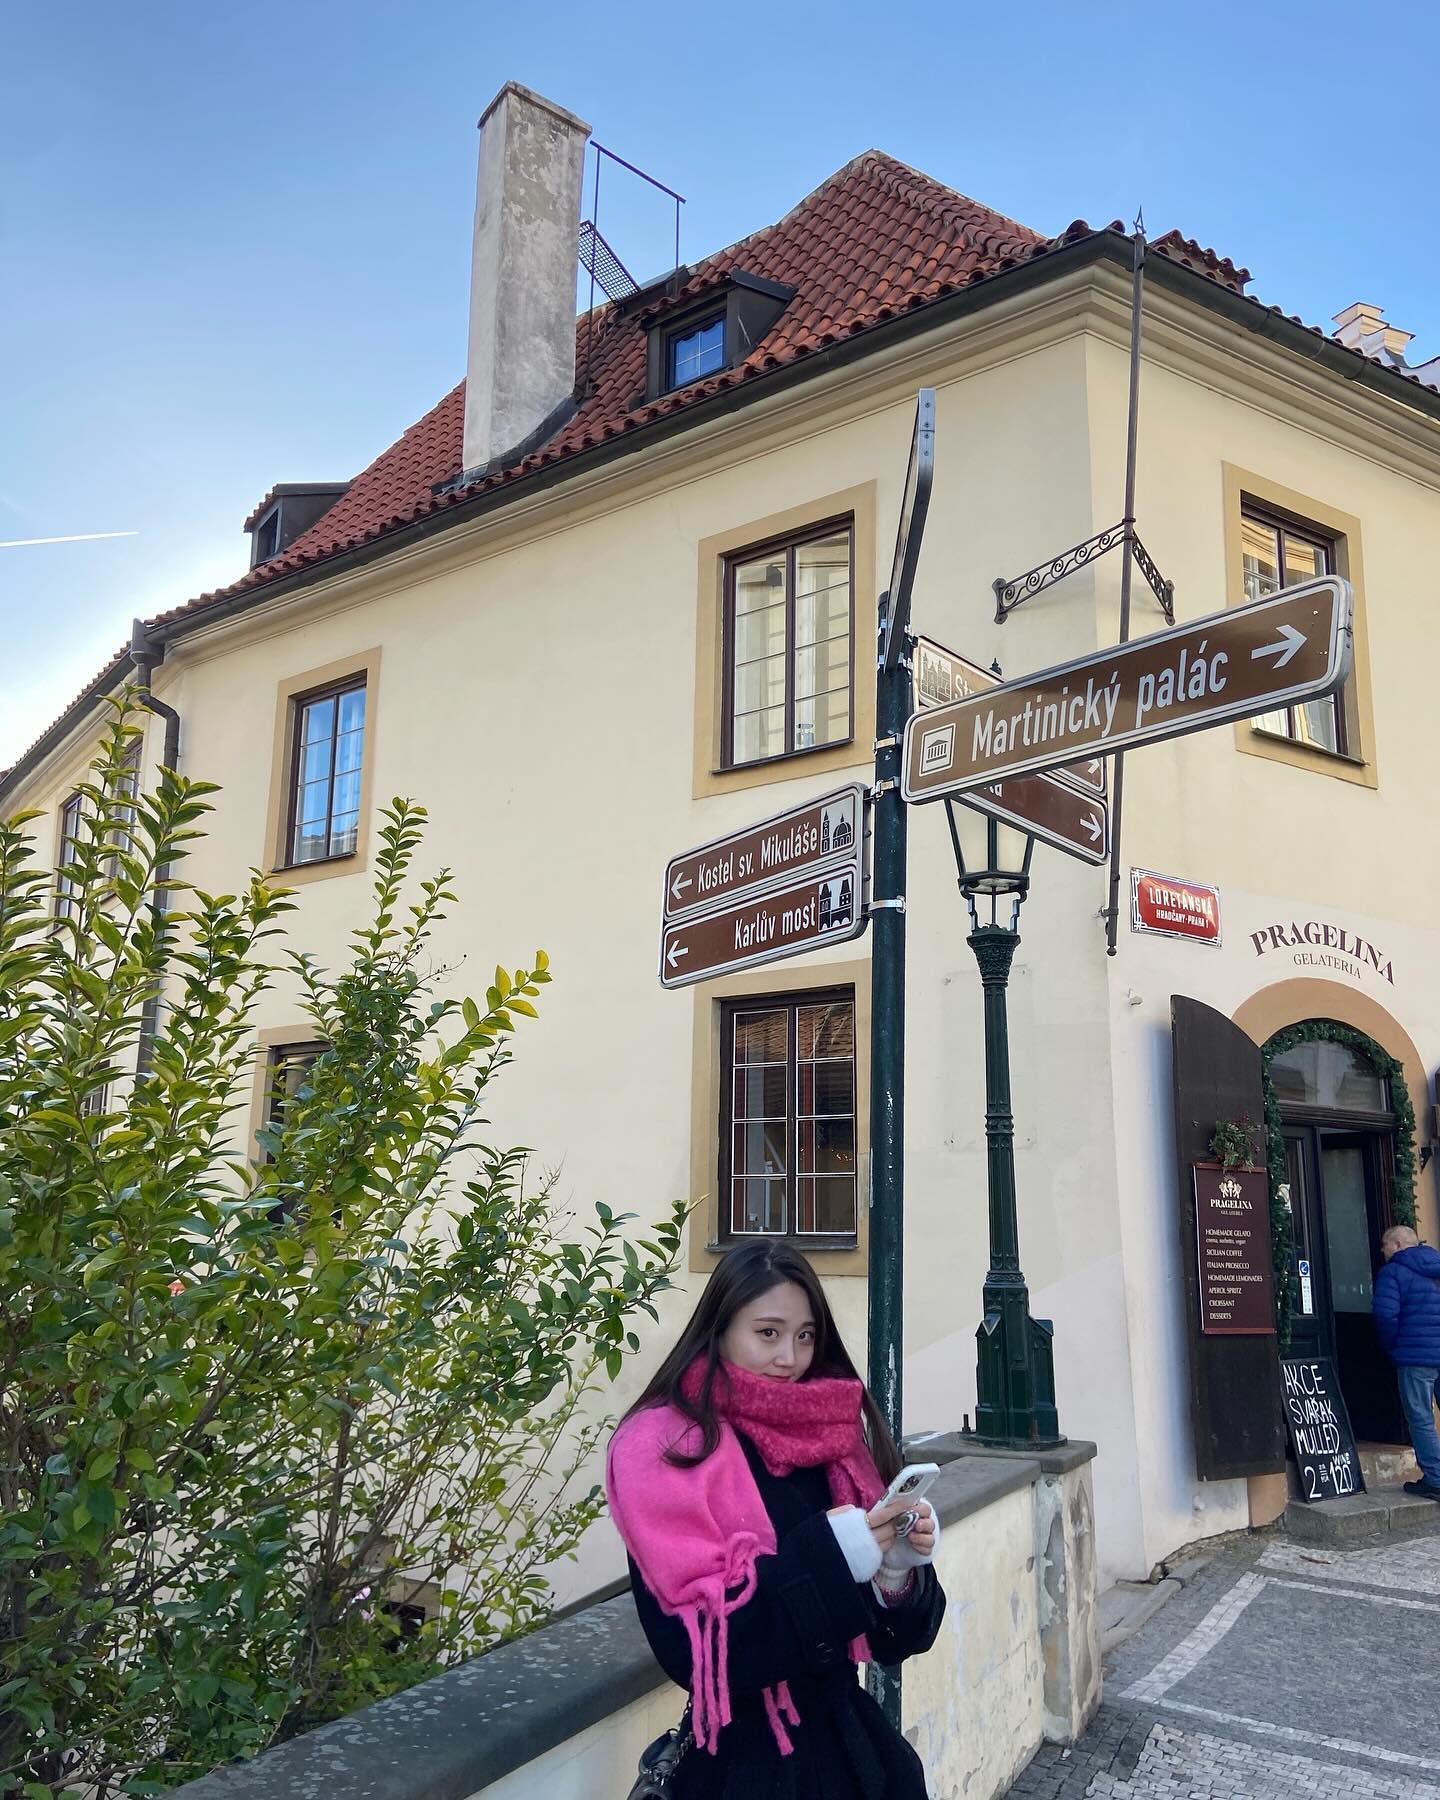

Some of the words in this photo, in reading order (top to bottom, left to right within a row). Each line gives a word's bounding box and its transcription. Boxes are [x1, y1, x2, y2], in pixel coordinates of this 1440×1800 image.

[971, 671, 1121, 762] Martinický
[1135, 640, 1229, 729] palác
[698, 852, 734, 893] Kostel
[738, 852, 755, 877] sv.
[760, 822, 818, 870] Mikuláše
[734, 910, 776, 950] Karlův
[782, 896, 816, 936] most
[1248, 921, 1395, 986] PRAGELINA
[1293, 952, 1362, 980] GELATERIA
[1210, 1198, 1253, 1210] PRAGELINA
[1205, 1229, 1233, 1237] HOMEMADE
[1206, 1261, 1225, 1269] ITALIAN
[1225, 1262, 1250, 1270] PROSECCO
[1226, 1249, 1243, 1257] COFFEE
[1226, 1287, 1242, 1295] SPRITZ
[1282, 1364, 1326, 1396] AKCE
[1295, 1422, 1340, 1456] MULLED
[1304, 1465, 1322, 1498] 2
[1329, 1461, 1353, 1495] 120
